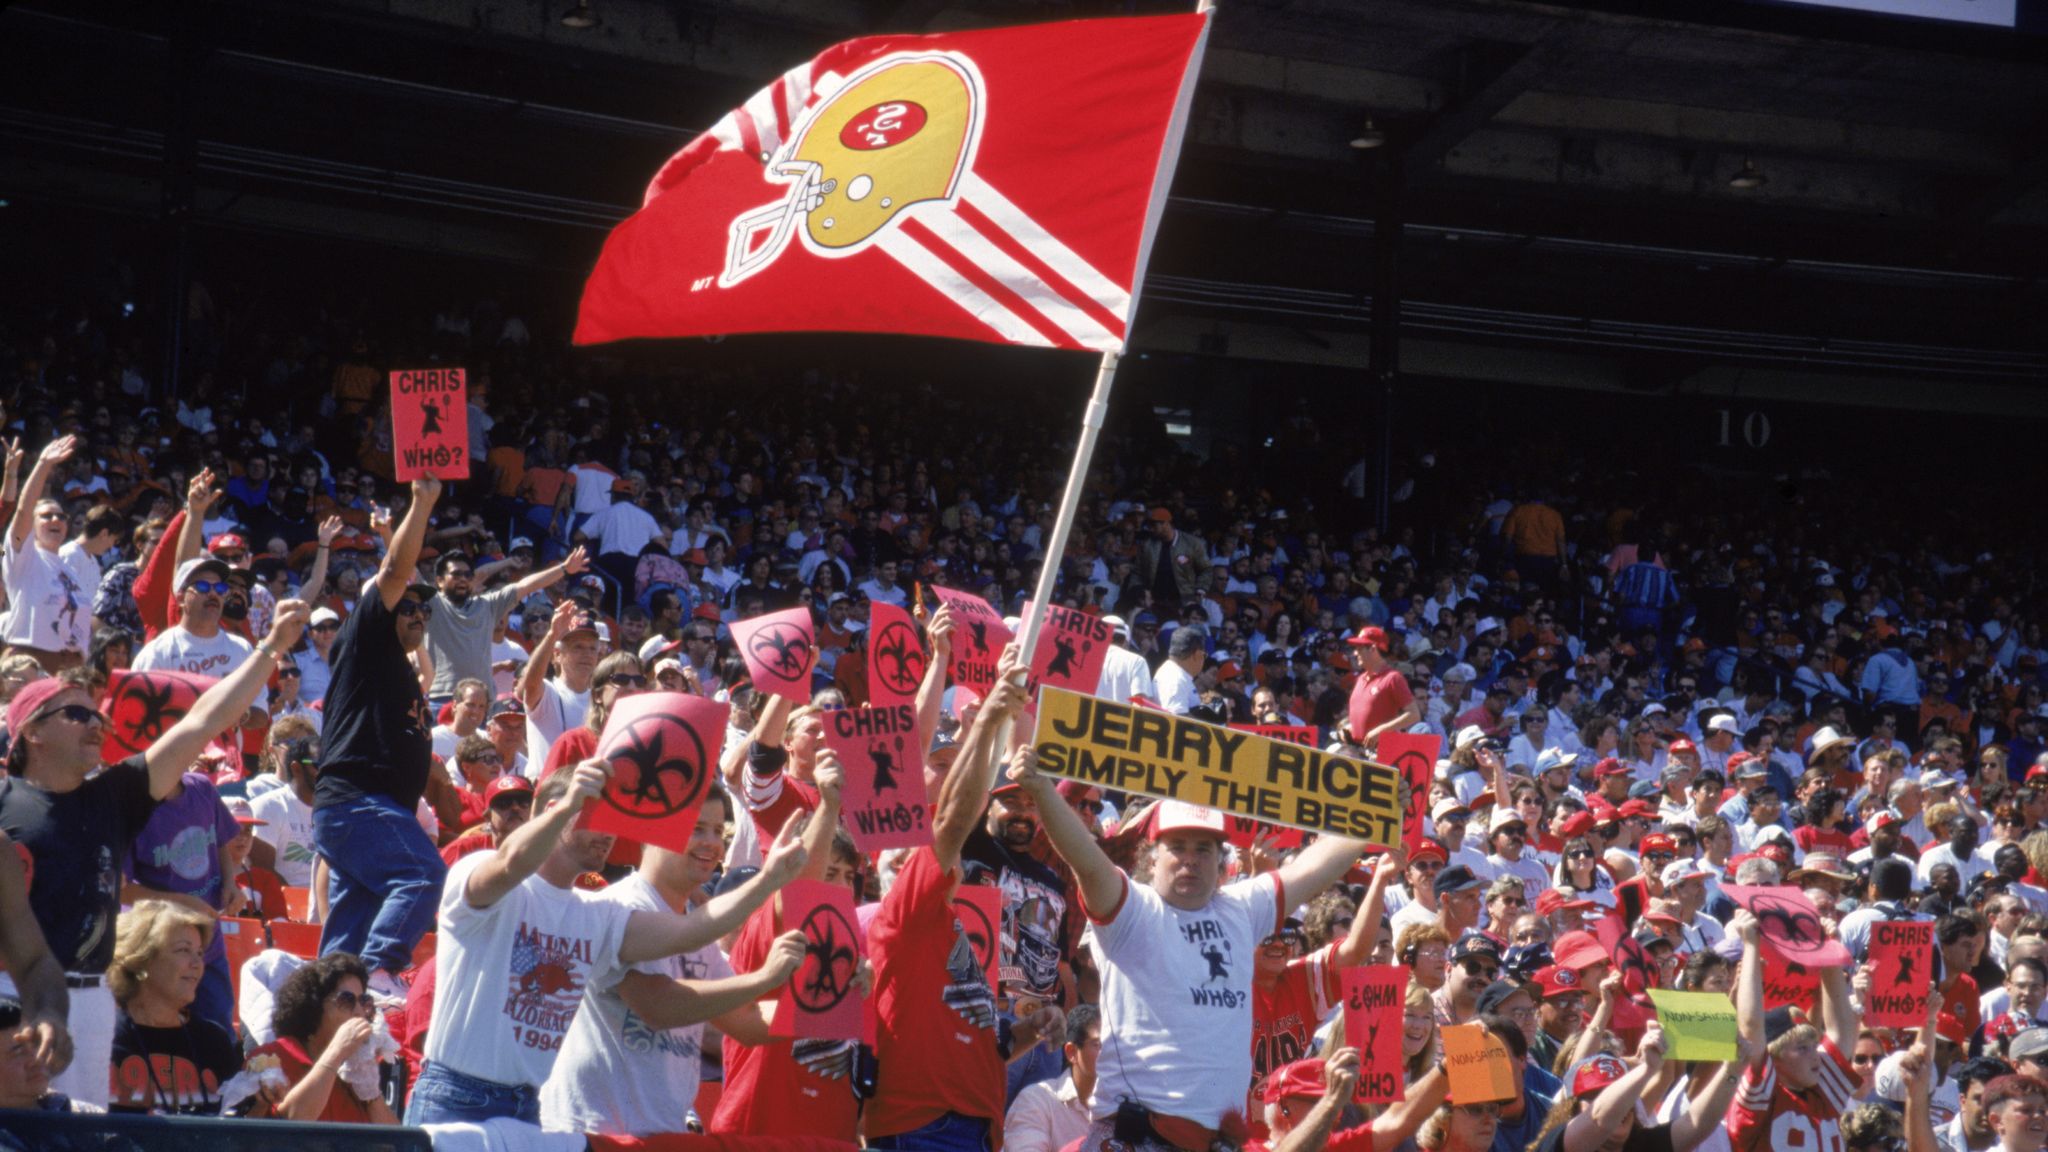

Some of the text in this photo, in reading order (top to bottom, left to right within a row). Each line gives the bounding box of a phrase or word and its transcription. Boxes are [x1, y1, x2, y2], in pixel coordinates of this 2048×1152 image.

[399, 369, 460, 394] CHRIS
[1716, 409, 1771, 448] 10
[957, 661, 996, 685] HRIS
[835, 705, 914, 738] CHRIS
[1053, 697, 1394, 809] JERRY RICE
[1036, 742, 1398, 845] SIMPLY THE BEST
[1180, 920, 1224, 943] HRI
[1878, 925, 1930, 945] CHRIS
[513, 1025, 563, 1052] 1994
[1358, 1072, 1396, 1097] CHR
